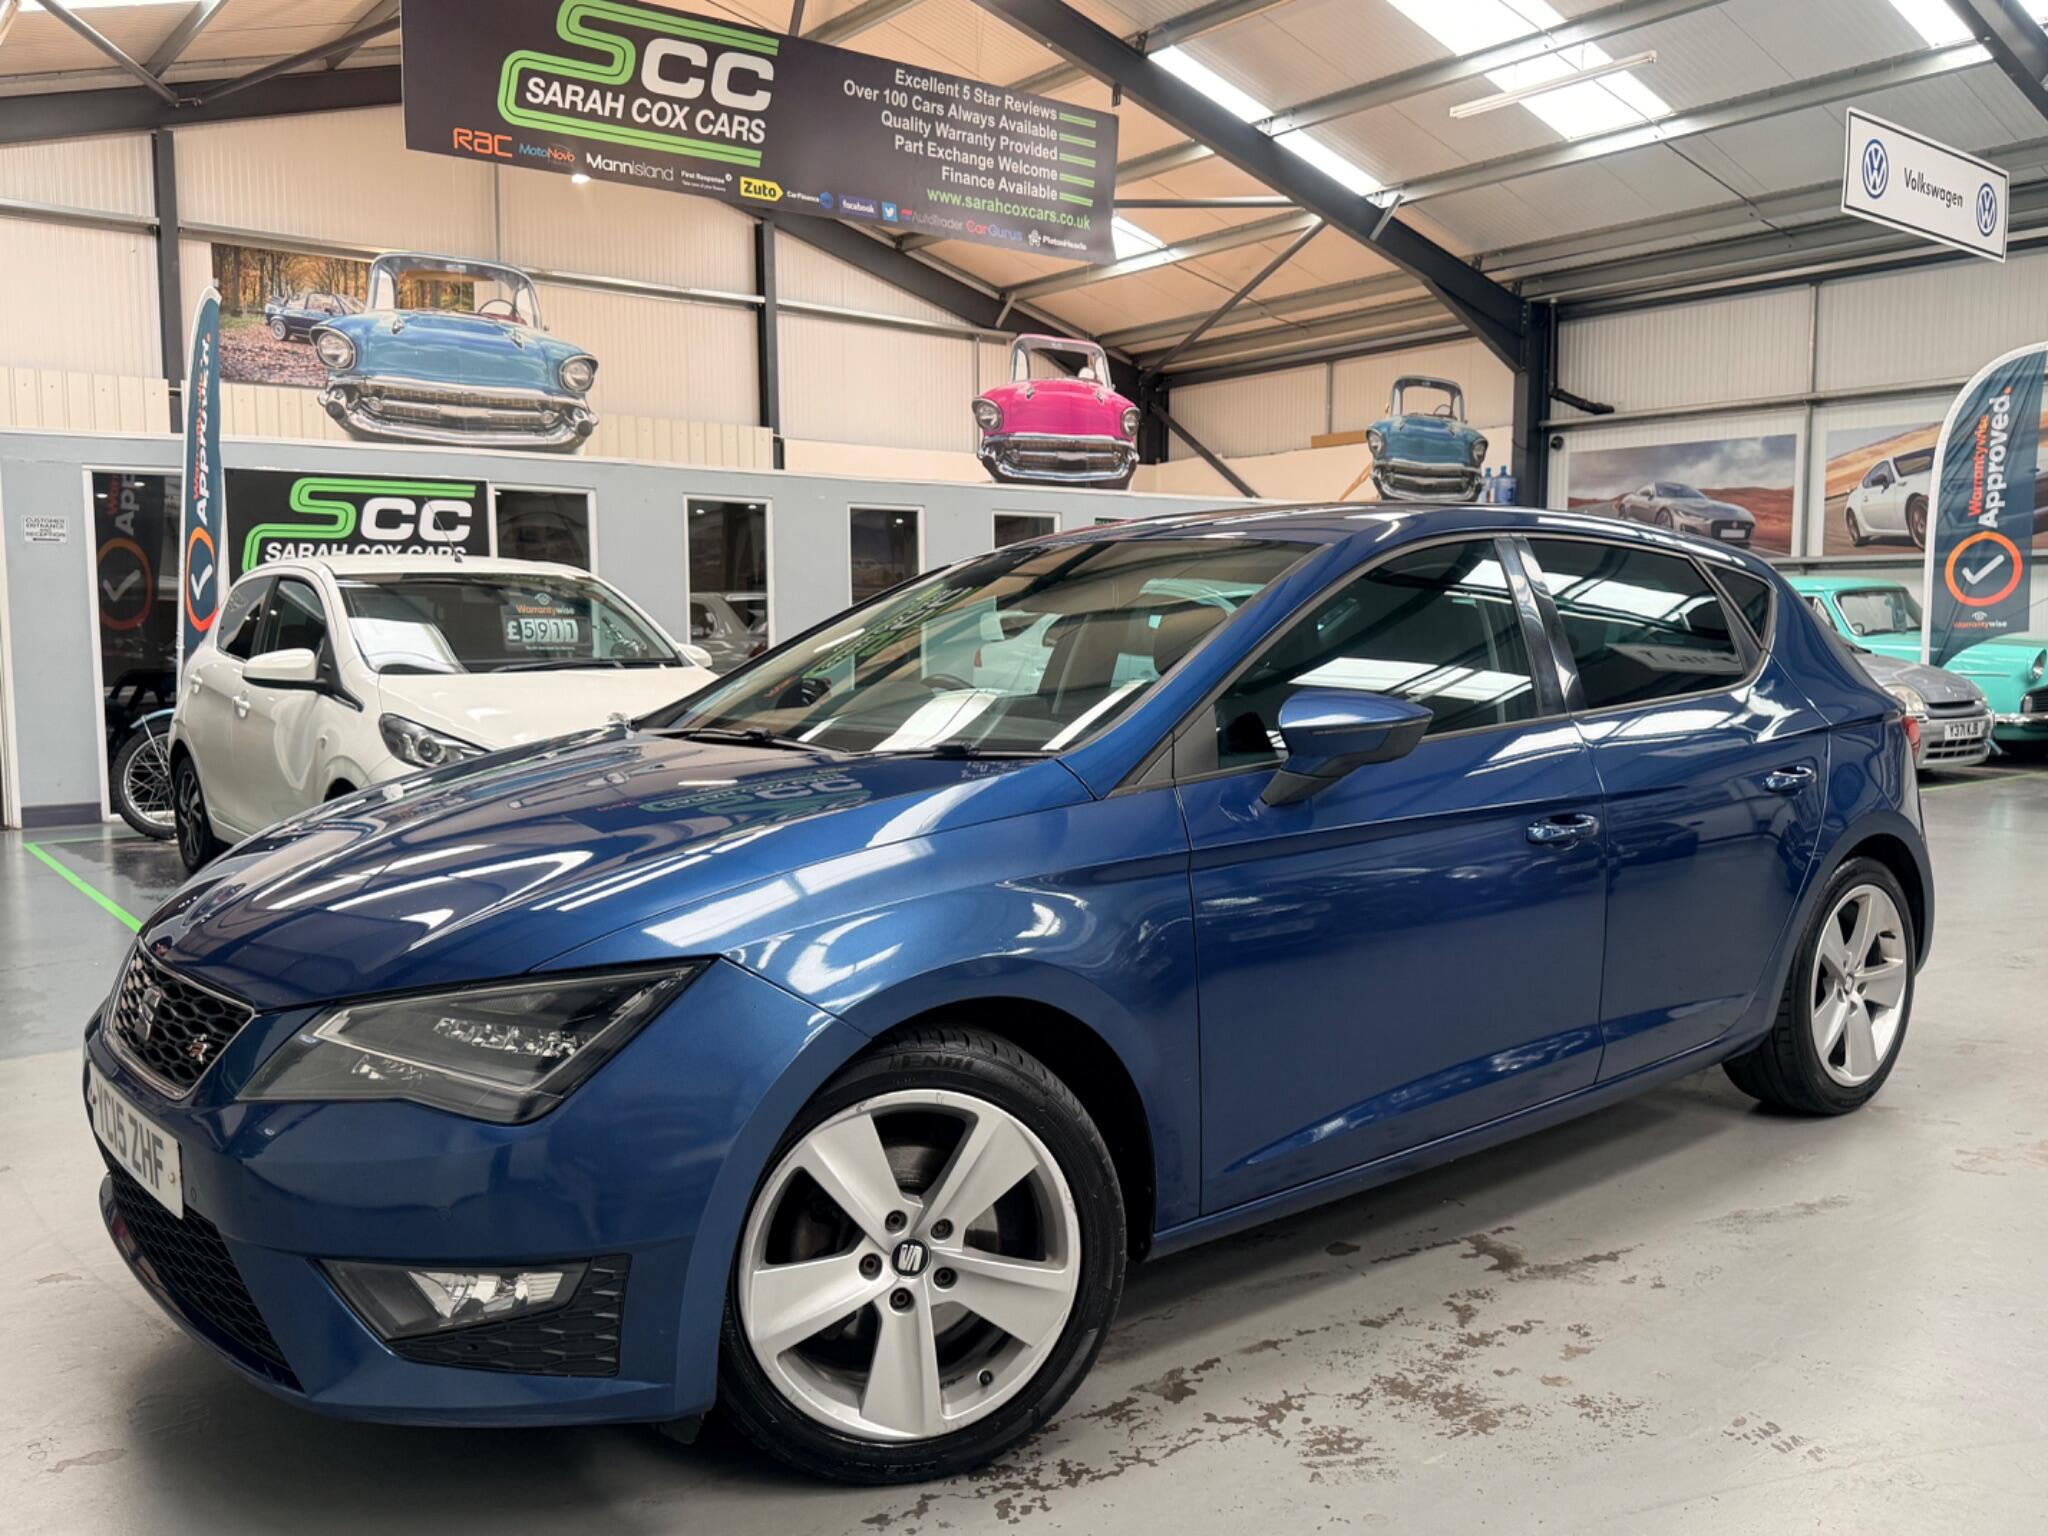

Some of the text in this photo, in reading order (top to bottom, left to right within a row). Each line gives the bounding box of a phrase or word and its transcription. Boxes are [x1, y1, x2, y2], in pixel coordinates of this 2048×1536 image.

[525, 77, 766, 144] SARAH COX CARS
[843, 79, 1058, 141] Over 100 Cars Always Available
[895, 68, 1058, 121] Excellent 5 Star Reviews
[881, 110, 1058, 161] Quality Warranty Provided
[895, 135, 1058, 181] Part Exchange Welcome
[743, 181, 777, 198] Zuto
[842, 199, 875, 214] facebook
[927, 187, 1090, 231] www.sarahcoxcars.co.uk
[942, 165, 1058, 202] Finance Available
[1904, 167, 1963, 208] Volkswagen
[1968, 414, 1989, 518] Warrantywise
[1977, 386, 2013, 528] Approved.
[96, 1078, 164, 1190] YC15 ZHF
